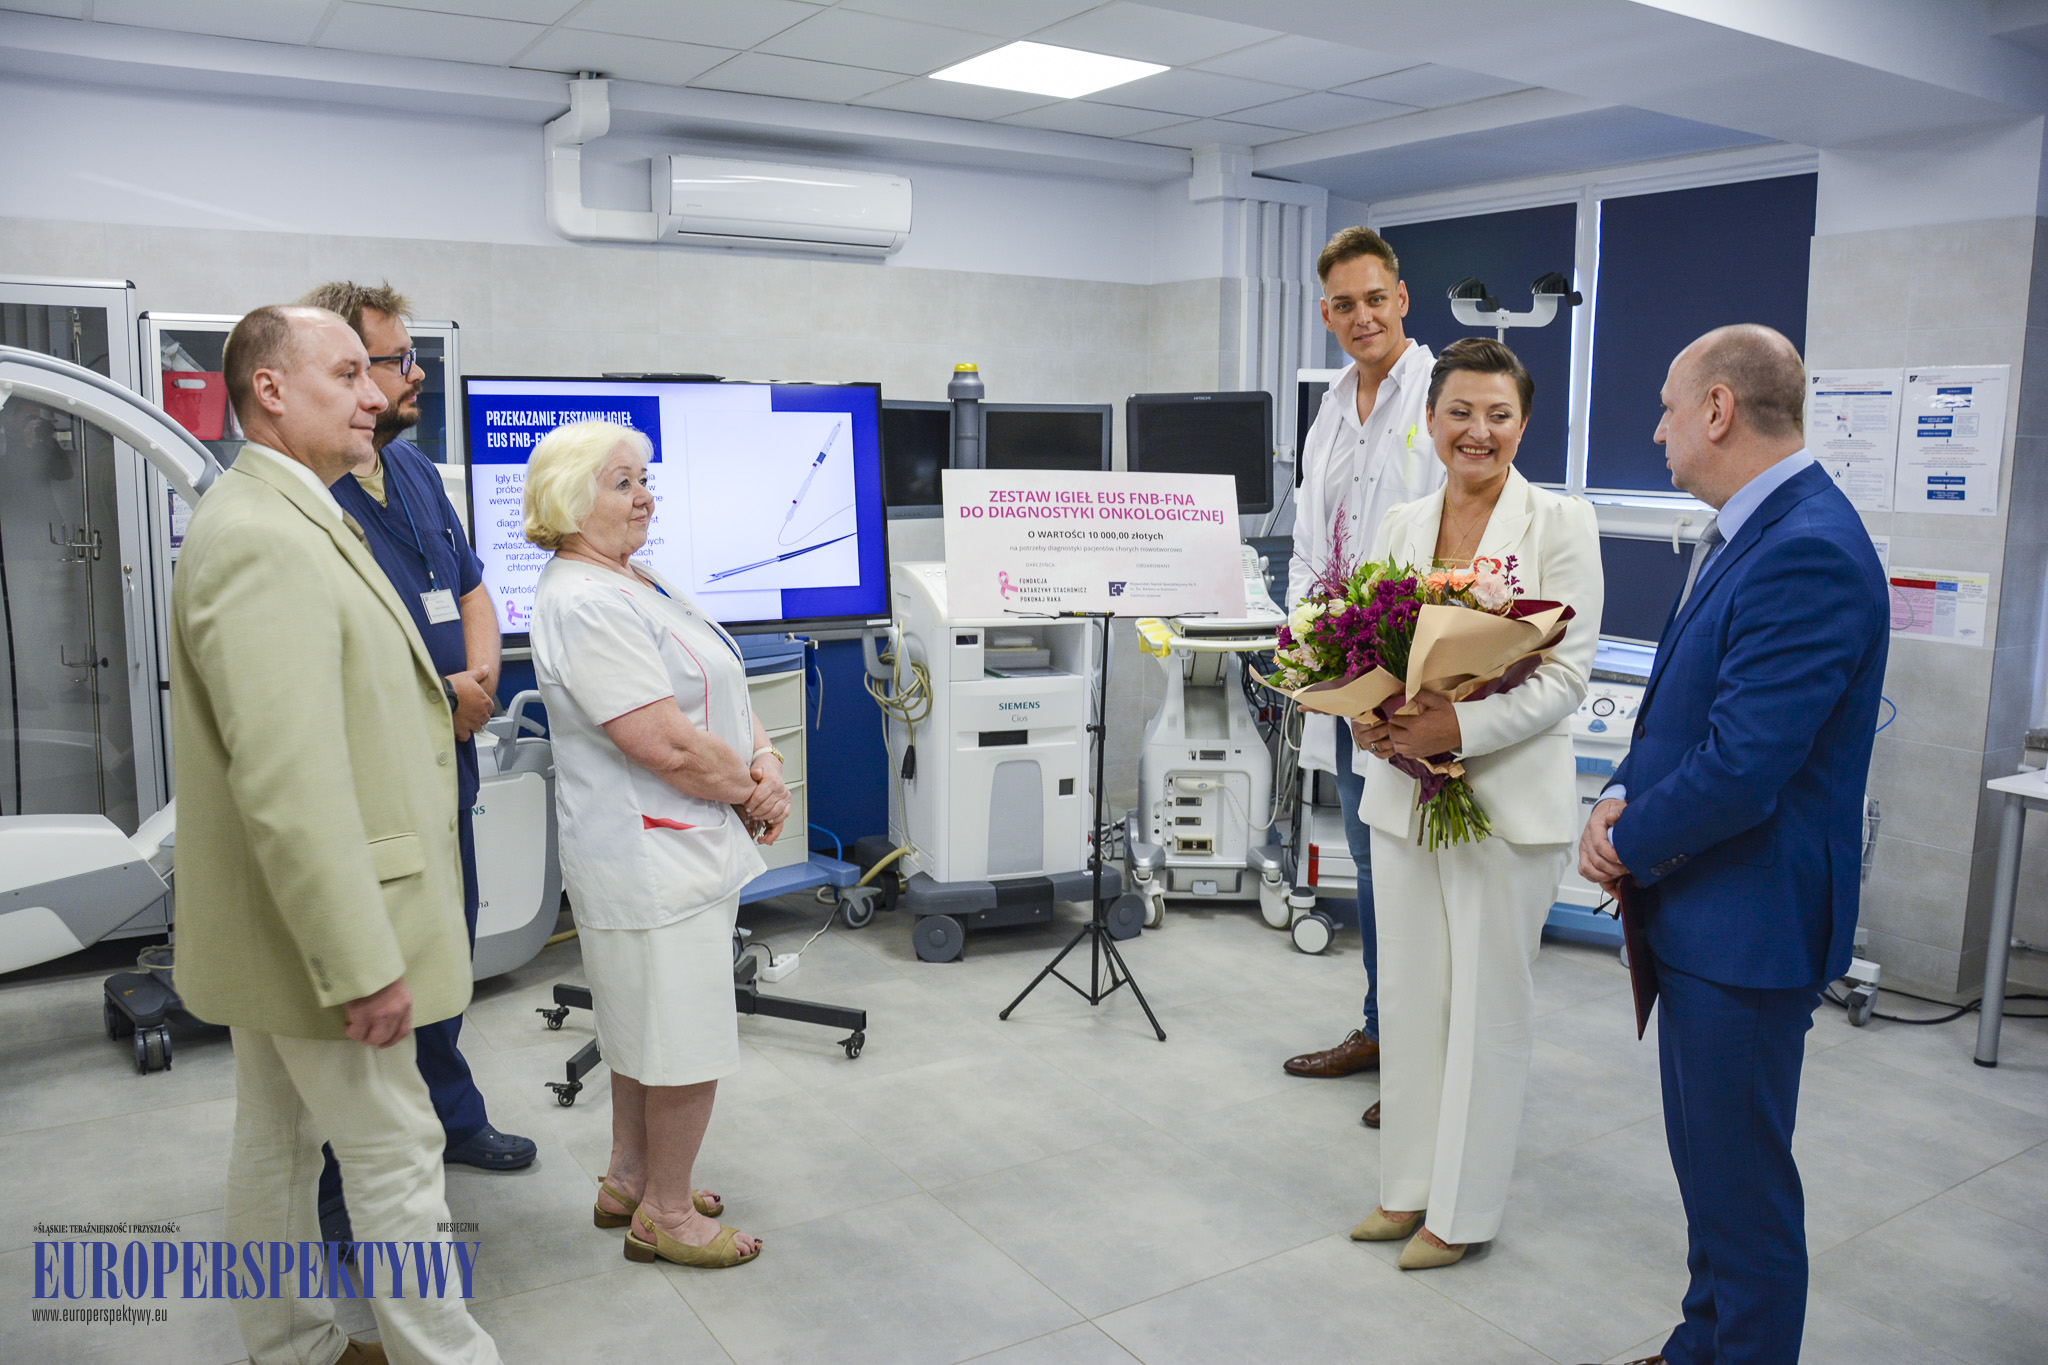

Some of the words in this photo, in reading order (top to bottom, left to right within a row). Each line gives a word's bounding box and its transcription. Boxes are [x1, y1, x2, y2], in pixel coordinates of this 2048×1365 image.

[486, 410, 556, 426] PRZEKAZANIE
[607, 411, 633, 426] IGIEŁ
[487, 432, 508, 448] EUS
[512, 473, 525, 482] EU
[495, 485, 523, 495] próbe
[488, 498, 521, 506] wewną
[989, 490, 1051, 503] ZESTAW
[1055, 491, 1094, 504] IGIEŁ
[1097, 492, 1126, 504] EUS
[1129, 493, 1196, 506] FNB-FNA
[960, 506, 984, 518] DO
[988, 506, 1095, 519] DIAGNOSTYKI
[1100, 507, 1225, 525] ONKOLOGICZNEJ
[1027, 530, 1036, 539] O
[1037, 529, 1086, 539] WARTOŚCI
[1088, 531, 1099, 540] 10
[1100, 532, 1129, 541] 000,00
[1131, 531, 1164, 542] złotych
[1019, 545, 1046, 553] potrzeby
[1047, 545, 1082, 553] diagnostyki
[505, 552, 551, 561] narządach
[507, 563, 546, 572] chłonnyc
[999, 701, 1041, 711] SIEMENS
[1011, 714, 1028, 723] Cios
